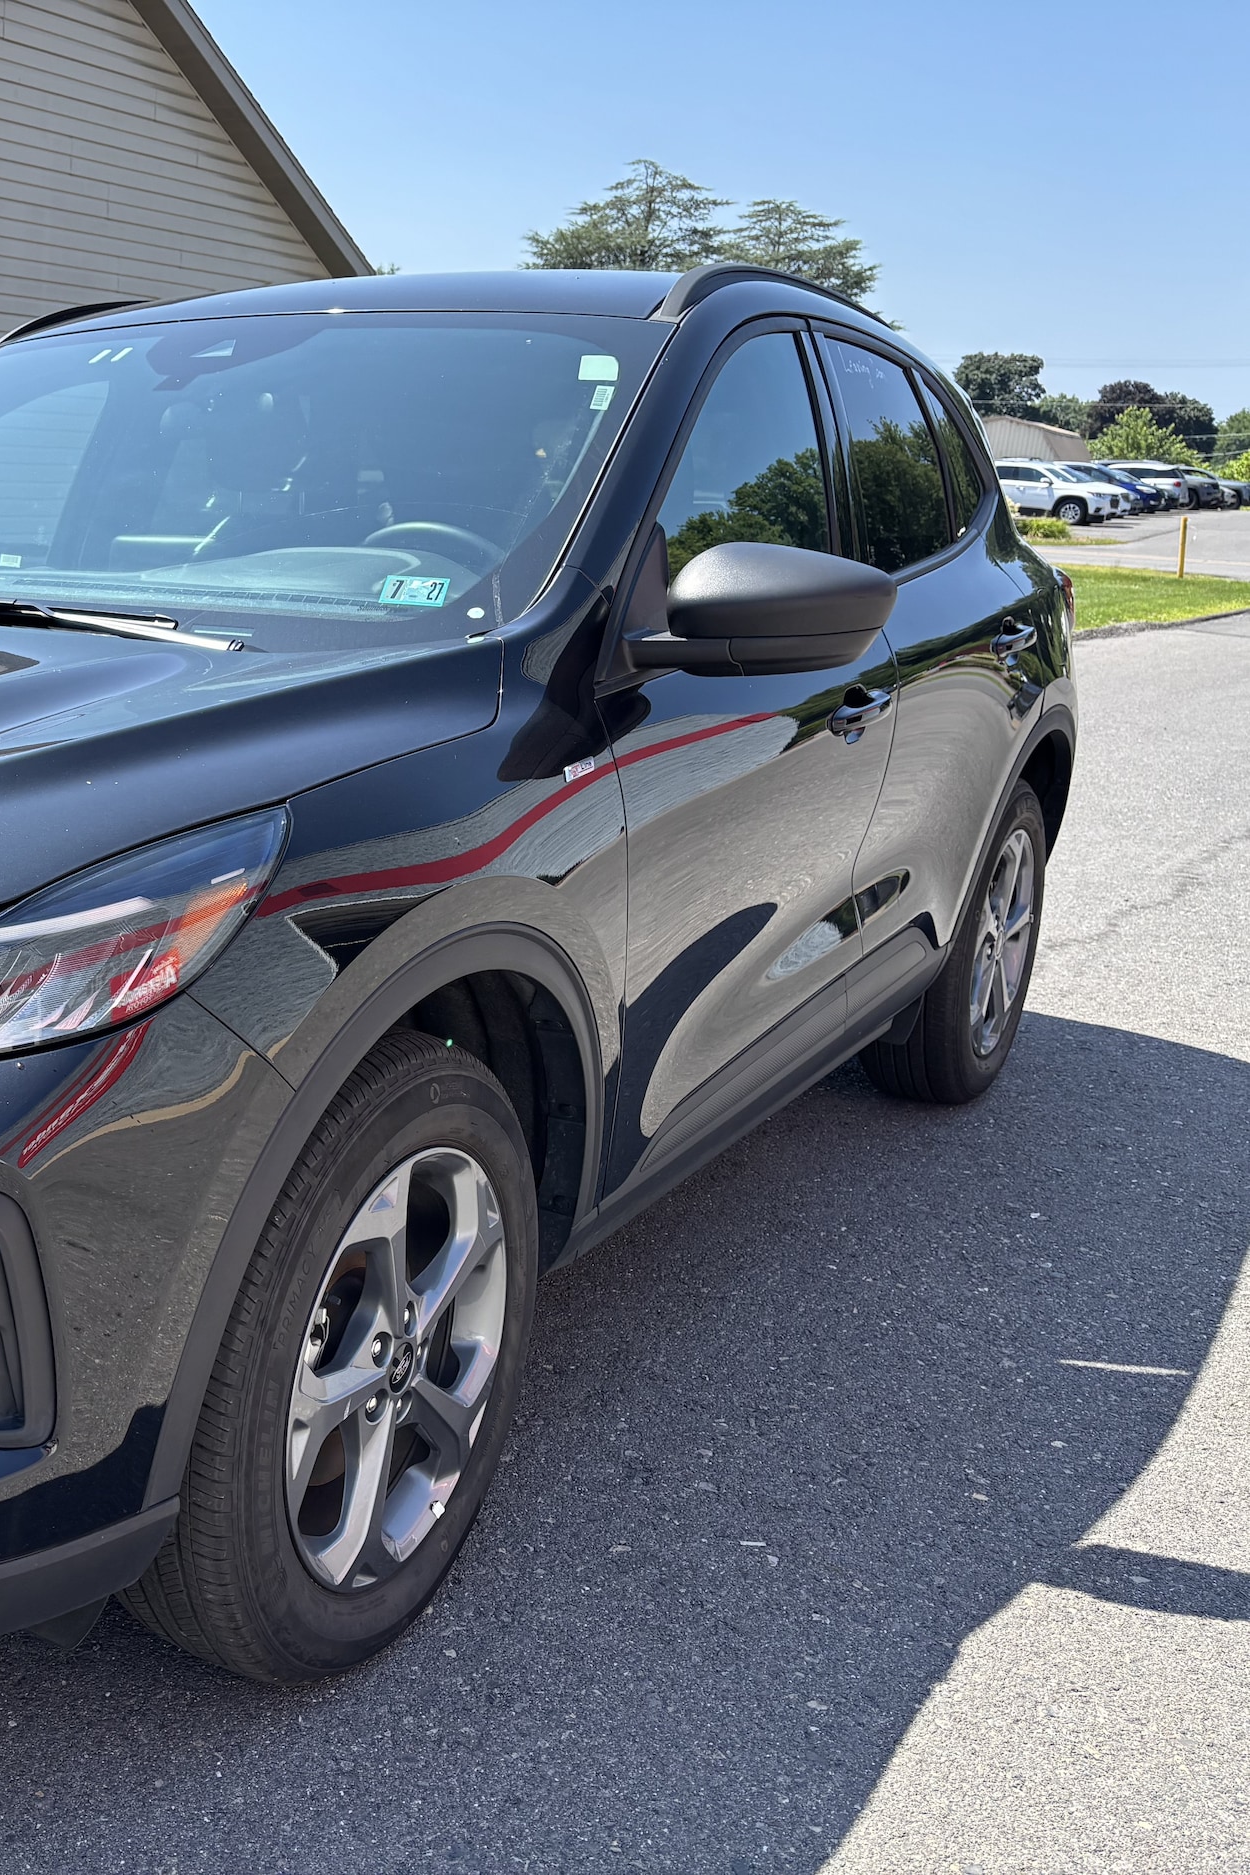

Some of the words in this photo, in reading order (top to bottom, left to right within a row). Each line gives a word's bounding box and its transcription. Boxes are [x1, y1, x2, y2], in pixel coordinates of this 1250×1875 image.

[390, 580, 404, 599] 7
[426, 581, 445, 601] 27
[276, 1242, 317, 1348] PRIMACY
[258, 1379, 281, 1552] MICHELIN
